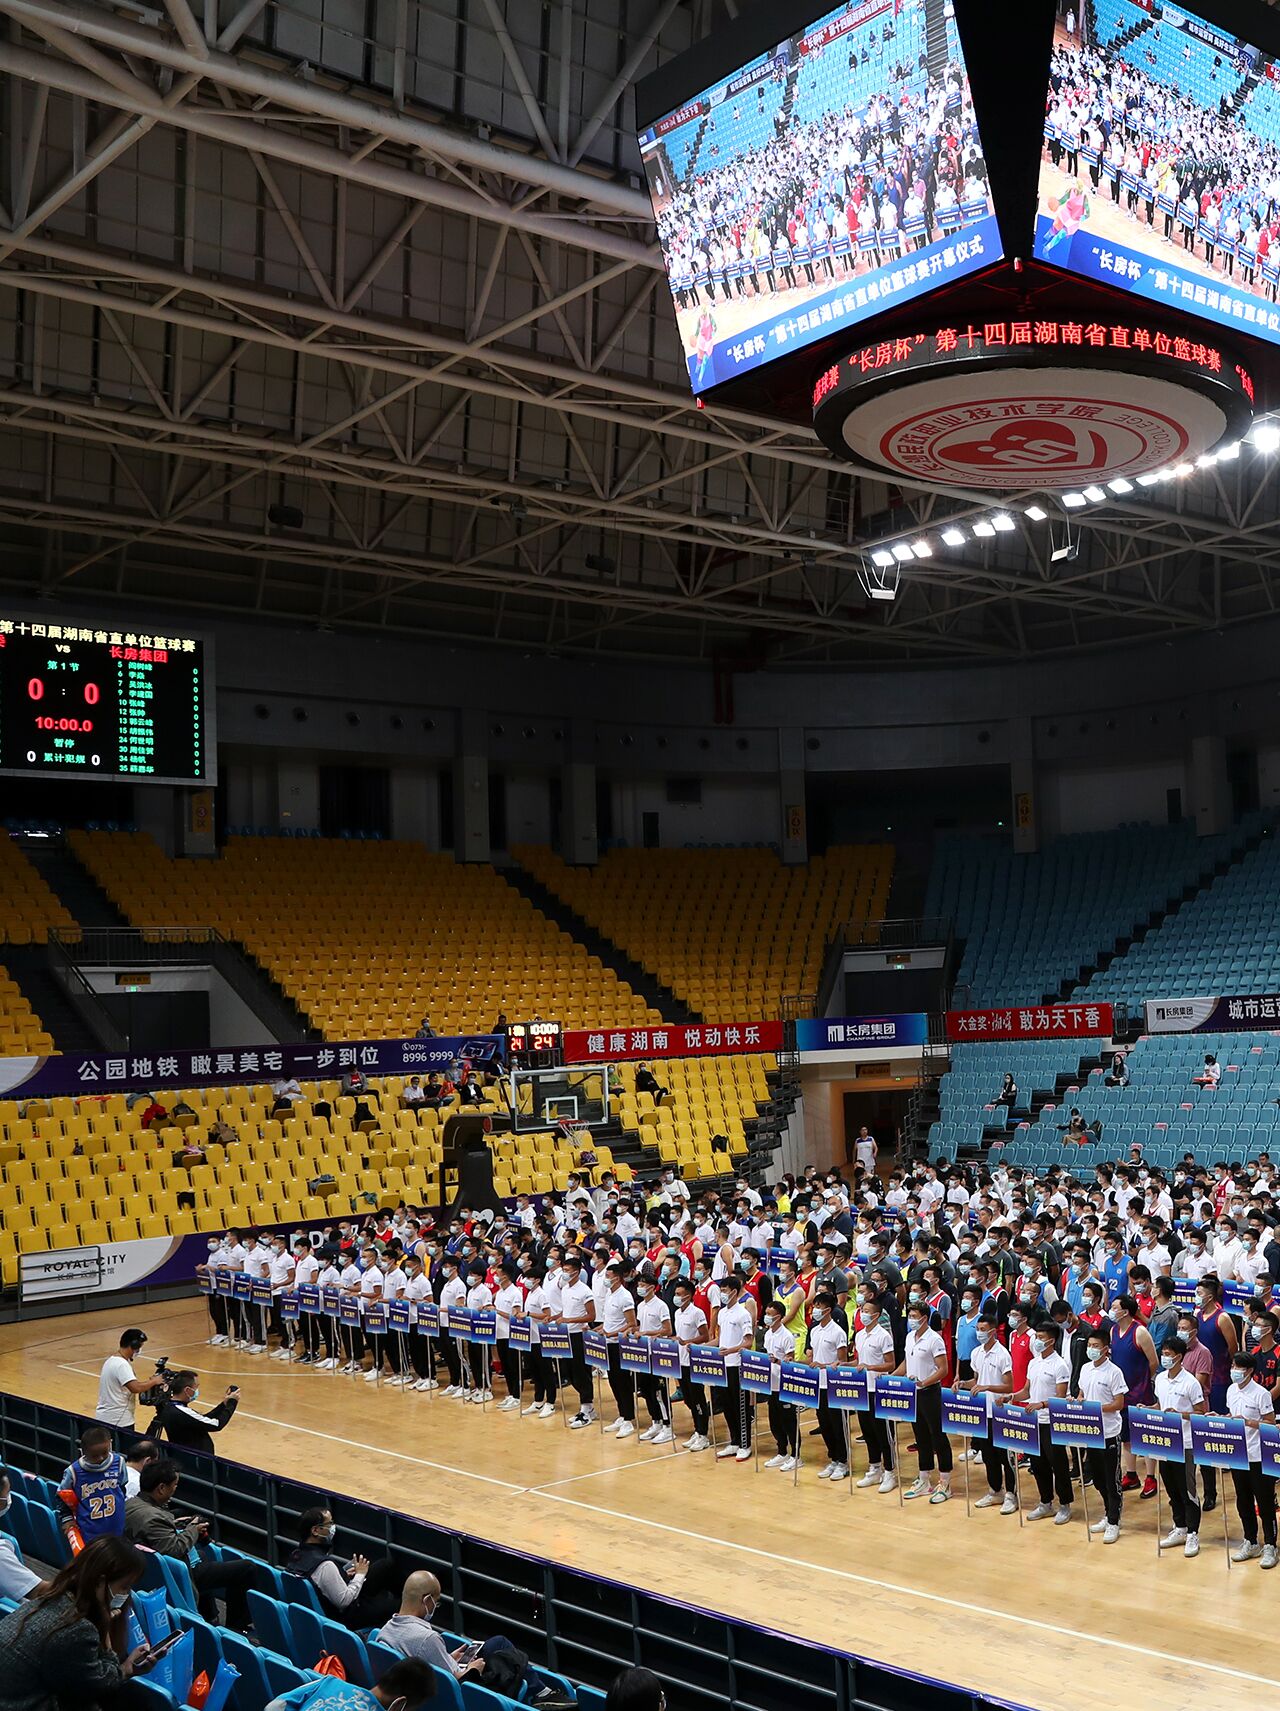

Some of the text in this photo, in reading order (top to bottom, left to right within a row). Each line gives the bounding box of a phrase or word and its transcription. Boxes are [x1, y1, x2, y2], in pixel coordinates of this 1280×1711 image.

[0, 620, 196, 652] 第十四届湖南省直单位篮球赛
[109, 645, 168, 663] 长房集团
[28, 678, 44, 700] 0
[84, 682, 99, 704] 0
[35, 716, 93, 732] 10:00.0
[27, 751, 36, 762] 0
[91, 755, 100, 766] 0
[1019, 1007, 1101, 1030] 敢为天下香
[1165, 1007, 1194, 1017] 长房集团
[846, 1023, 896, 1037] 长房集团
[534, 1036, 553, 1050] 24
[587, 1025, 761, 1053] 健康湖南 悦动快乐
[77, 1046, 380, 1082] 公园地铁 瞰景美宅 一步到位
[402, 1051, 454, 1063] 8996 9999
[693, 1365, 723, 1376] 省人大常委会
[1002, 1427, 1029, 1441] 省委党校
[1141, 1433, 1172, 1448] 省发改委
[1204, 1442, 1235, 1455] 省科技厅
[90, 1494, 116, 1519] 23
